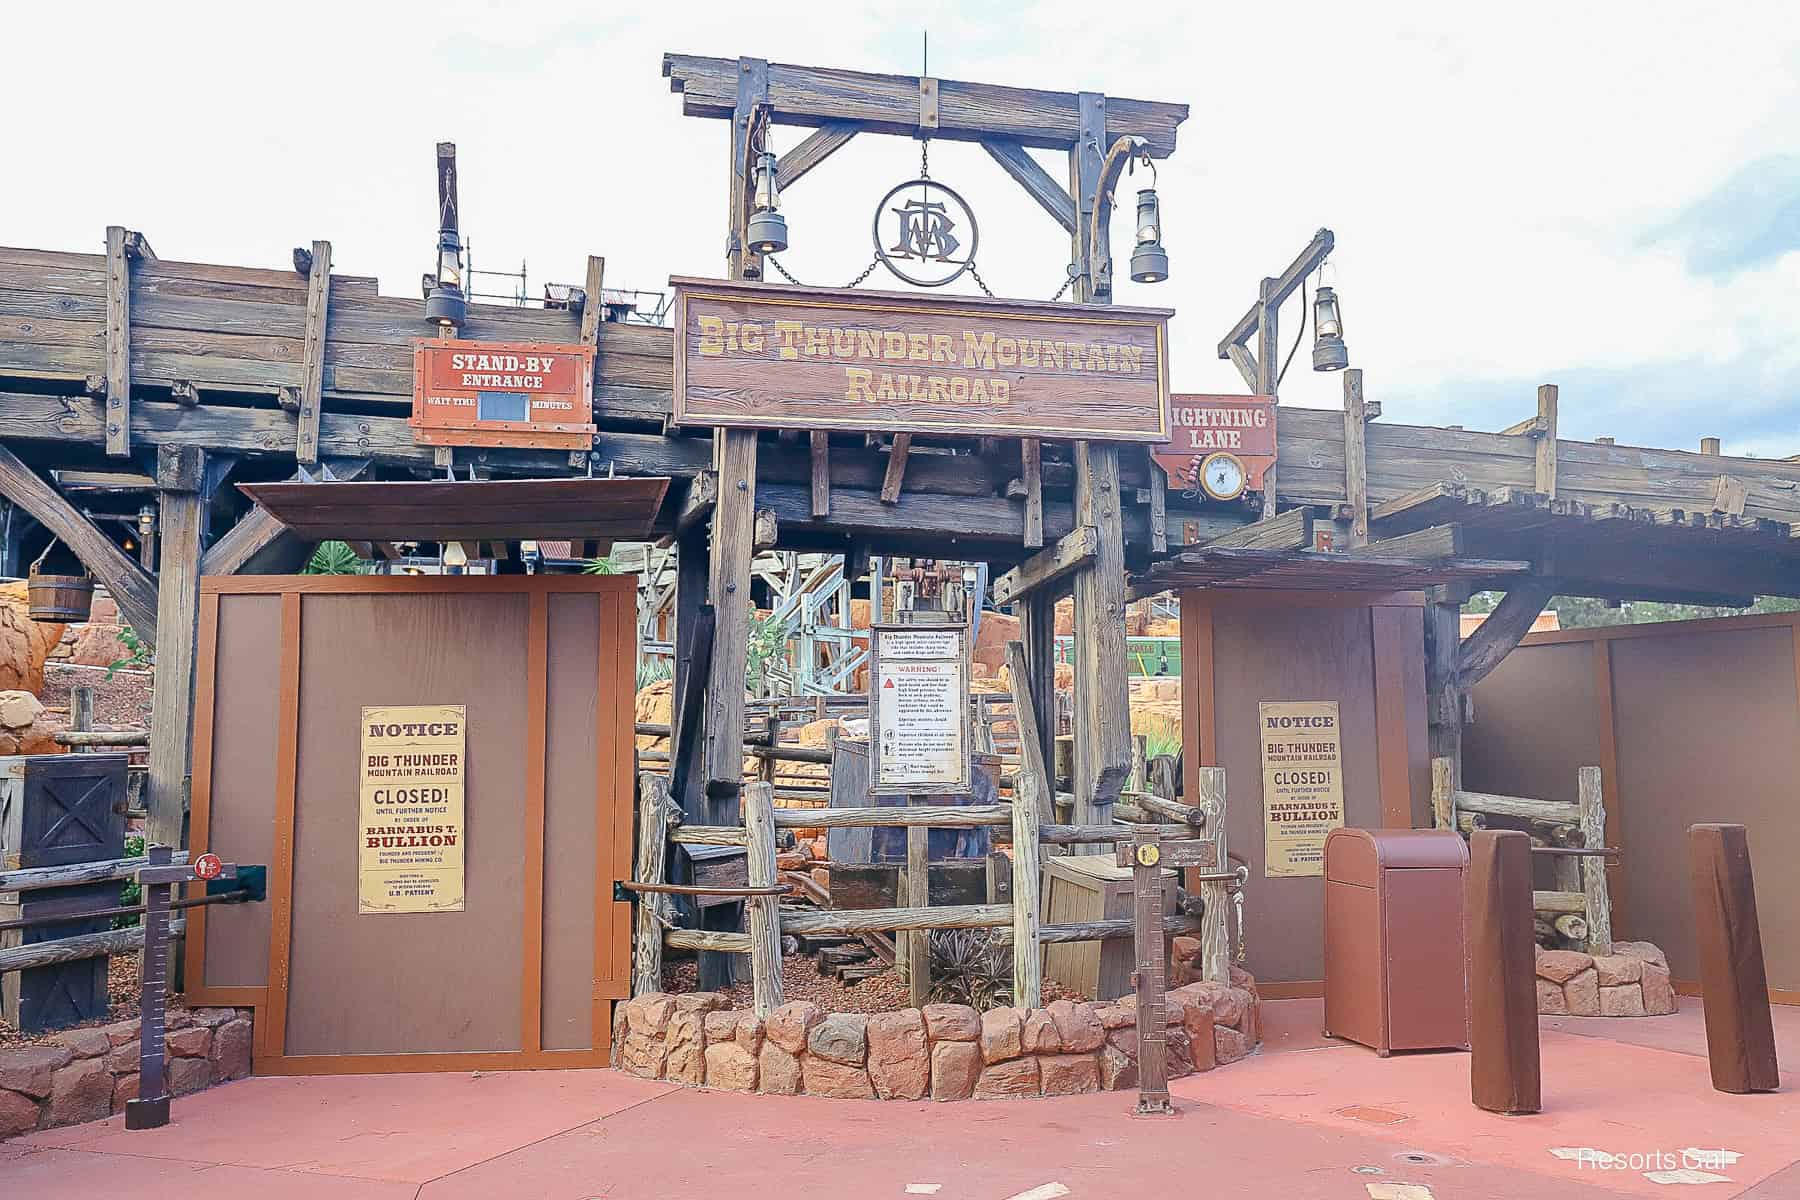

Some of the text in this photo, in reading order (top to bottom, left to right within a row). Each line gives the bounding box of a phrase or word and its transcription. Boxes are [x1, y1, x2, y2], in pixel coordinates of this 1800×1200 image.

[698, 315, 1143, 373] BIG THUNDER MOUNTAIN
[452, 354, 554, 373] STAND-BY
[462, 373, 543, 388] ENTRANCE
[845, 367, 1010, 404] RAILROAD
[428, 397, 476, 407] WAIT TIME
[532, 401, 573, 410] MINUTES
[1171, 407, 1267, 428] IGHTNING
[1189, 430, 1241, 449] LANE
[1266, 717, 1334, 728] NOTICE
[369, 723, 458, 737] NOTICE
[1268, 743, 1336, 753] BIG THUNDER
[368, 754, 458, 767] BIG THUNDER
[367, 767, 458, 777] MOUNTAIN RAILROAD
[1274, 771, 1330, 785] CLOSED!
[374, 788, 448, 804] CLOSED!
[376, 807, 394, 815] UNTIL
[424, 806, 447, 814] NOTICE
[1270, 810, 1339, 822] BULLION
[366, 825, 457, 835] BARNABUS T.
[366, 835, 457, 848] BULLION
